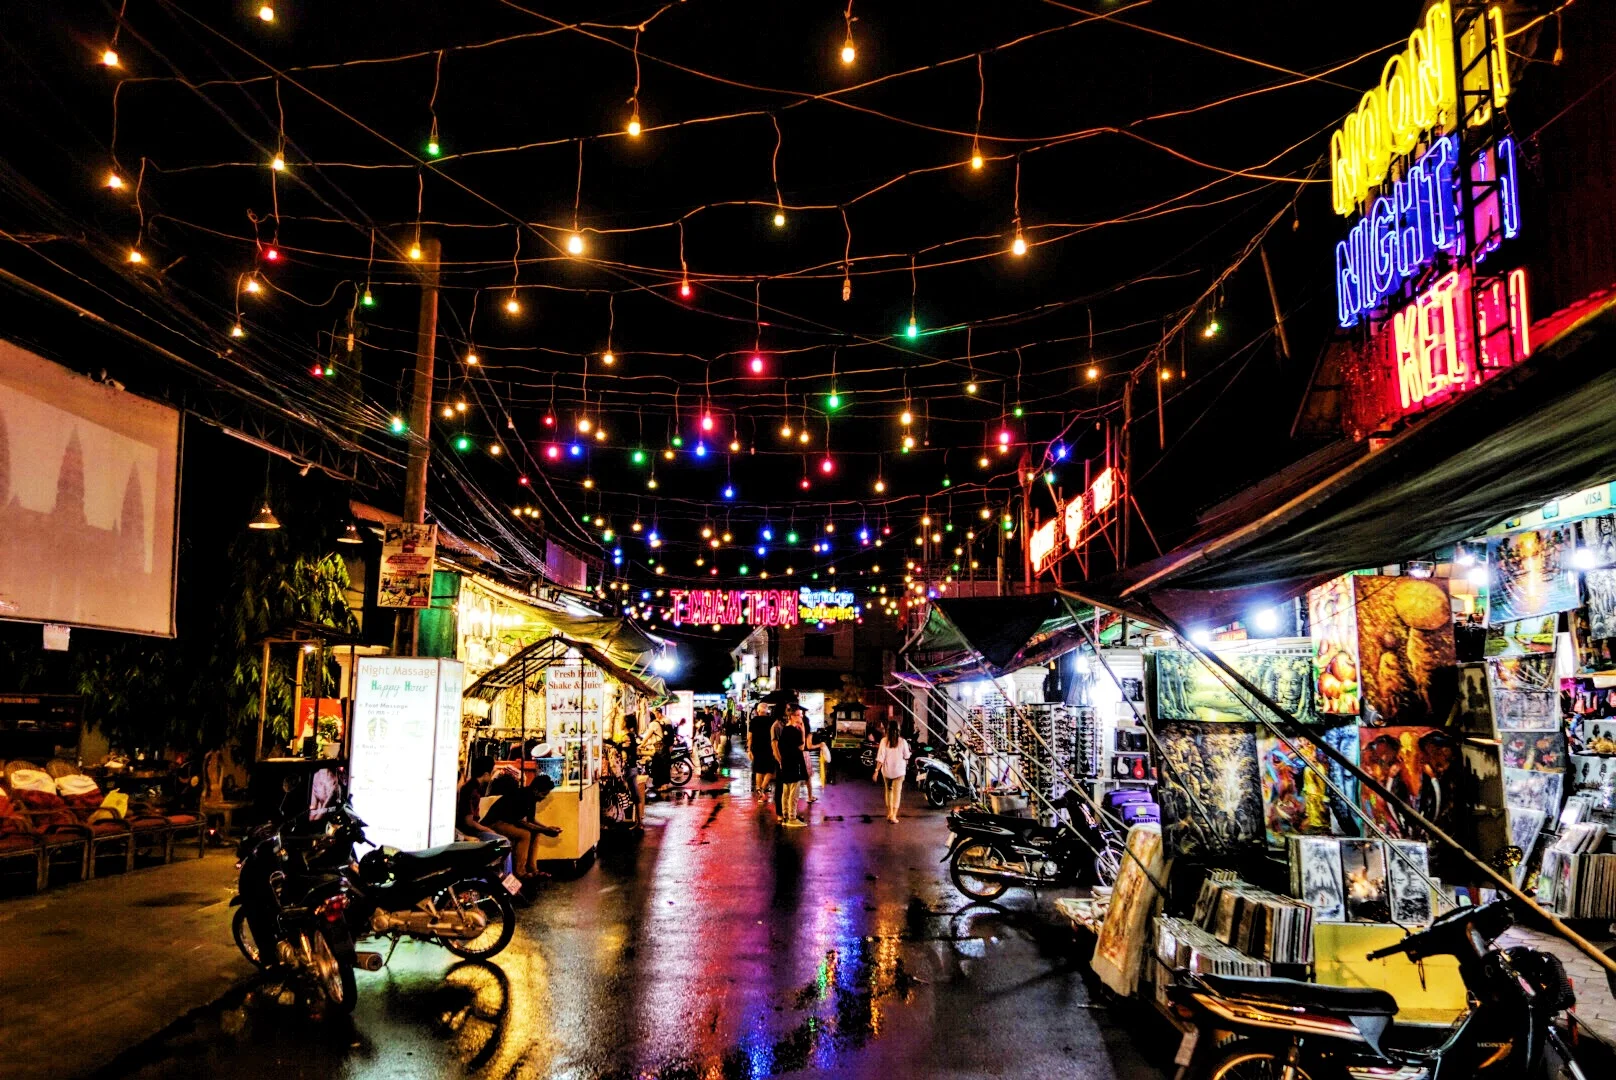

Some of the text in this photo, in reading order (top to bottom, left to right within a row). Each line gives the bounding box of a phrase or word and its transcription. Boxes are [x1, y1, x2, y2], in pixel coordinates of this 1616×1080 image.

[1336, 136, 1453, 327] NIGHT
[1584, 491, 1602, 505] VISA
[361, 665, 436, 678] Night Massage
[554, 670, 576, 678] Fresh
[371, 680, 400, 698] Happy
[404, 681, 429, 692] Hour
[548, 681, 602, 690] Shake & Juice
